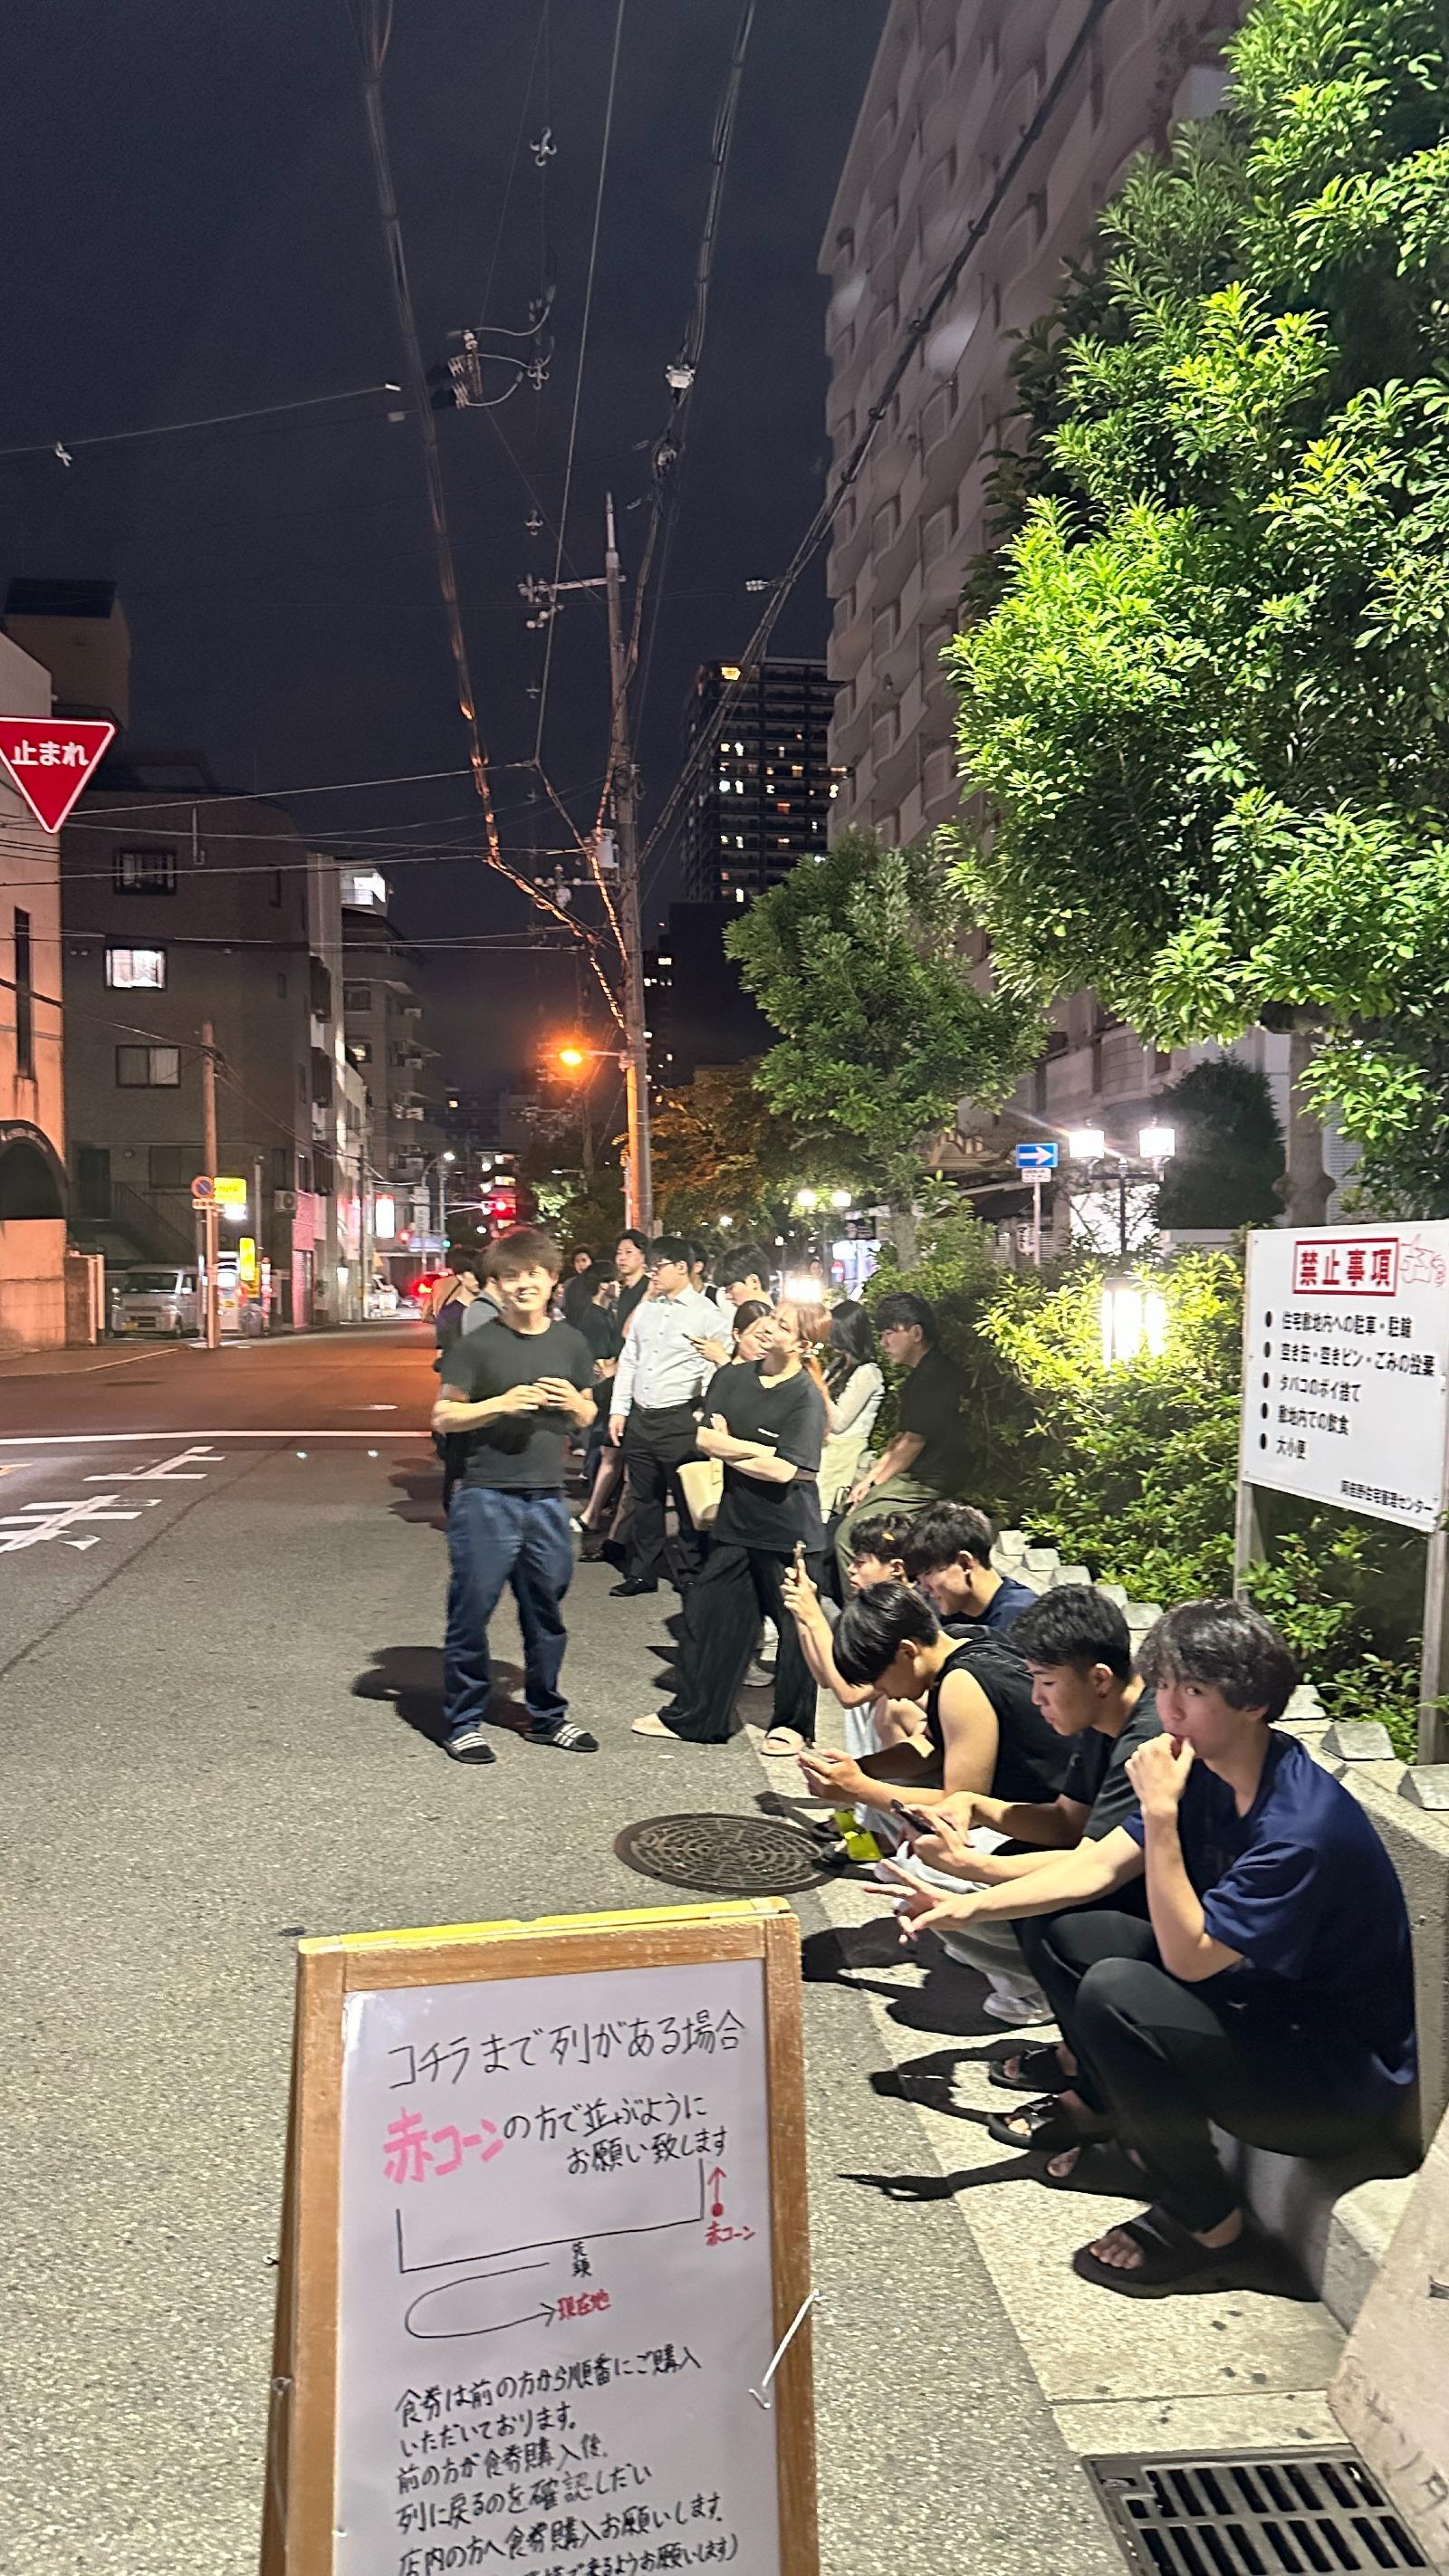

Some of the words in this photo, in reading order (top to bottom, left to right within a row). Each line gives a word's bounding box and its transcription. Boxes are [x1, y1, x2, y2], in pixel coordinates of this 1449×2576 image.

[10, 740, 90, 767] 止まれ
[1300, 1249, 1392, 1287] 禁止事項
[1280, 1375, 1361, 1402] タバコのポイ捨て
[1278, 1404, 1348, 1435] 敷地内での飲食
[1276, 1436, 1306, 1460] 大小便
[388, 2008, 745, 2089] コチラまで列がある場合
[382, 2092, 708, 2184] 赤コーンの方で並ぶように
[566, 2125, 727, 2174] お願い致します
[705, 2220, 755, 2246] 赤コーン
[556, 2289, 611, 2321] 現在地
[395, 2342, 702, 2428] 食券は前の方から順番にご購入
[400, 2400, 576, 2457] いただいております。
[396, 2462, 653, 2533] 列に戻るのを確認しだい
